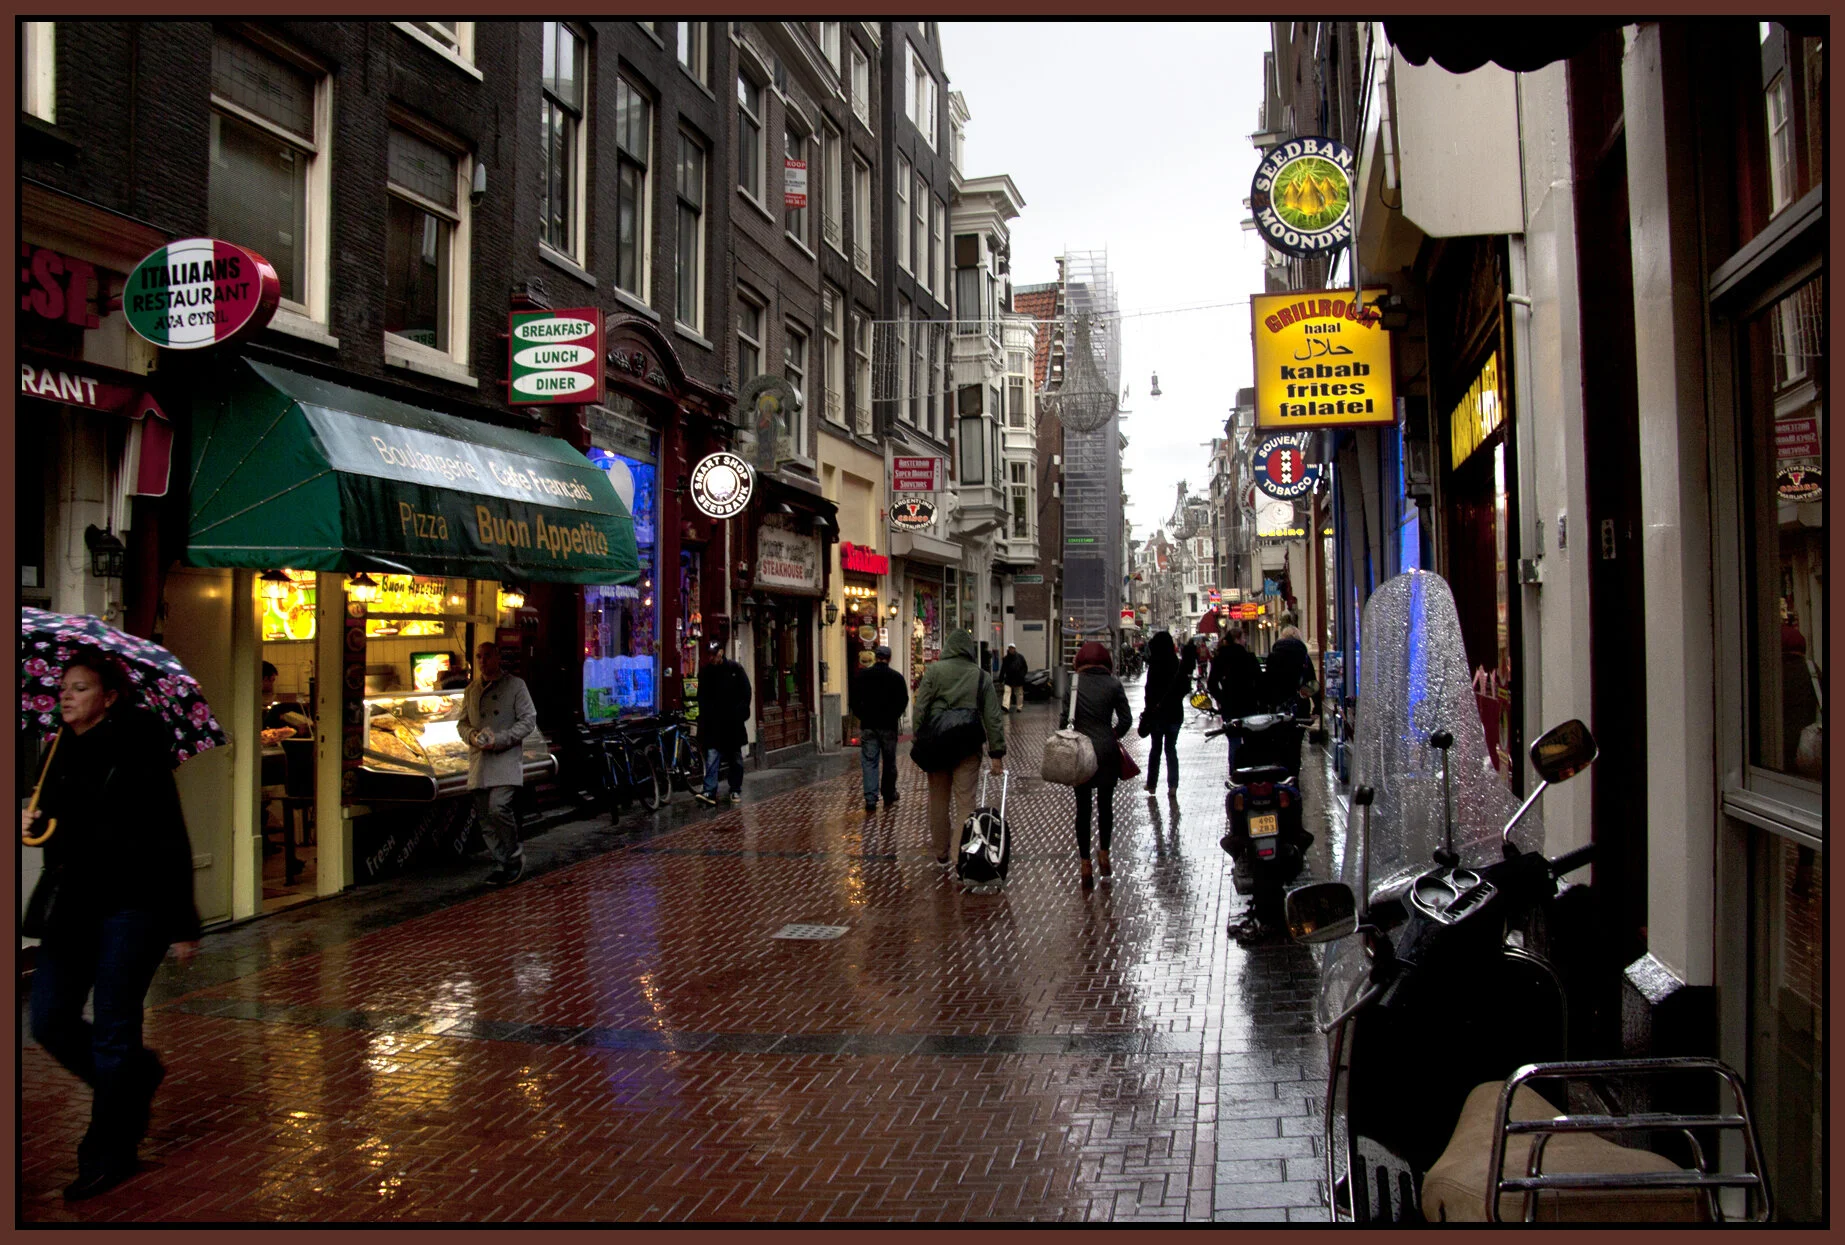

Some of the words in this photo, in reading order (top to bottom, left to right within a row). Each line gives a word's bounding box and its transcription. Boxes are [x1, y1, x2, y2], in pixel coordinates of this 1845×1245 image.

[1256, 139, 1353, 192] SEEDBAN
[141, 257, 240, 289] ITALIAANS
[22, 246, 100, 328] ST
[133, 282, 250, 312] RESTAURANT
[1264, 299, 1381, 333] GRILLROOM
[521, 321, 591, 338] BREAKFAST
[1304, 323, 1341, 334] halal
[534, 350, 579, 364] LUNCH
[1294, 338, 1354, 360] حلال
[1280, 362, 1371, 380] kabab
[535, 376, 576, 391] DINER
[1286, 382, 1365, 398] frites
[1279, 398, 1374, 417] falafel
[370, 435, 480, 481] Boulangerie
[694, 456, 720, 490] SMART
[722, 456, 749, 480] SHOP
[1263, 476, 1312, 496] TOBACCO
[697, 485, 749, 514] SEEDBANK
[399, 502, 449, 541] Pizza
[475, 504, 531, 549] Buon
[536, 513, 609, 560] Appetito
[762, 559, 804, 580] STEAKHOUSE
